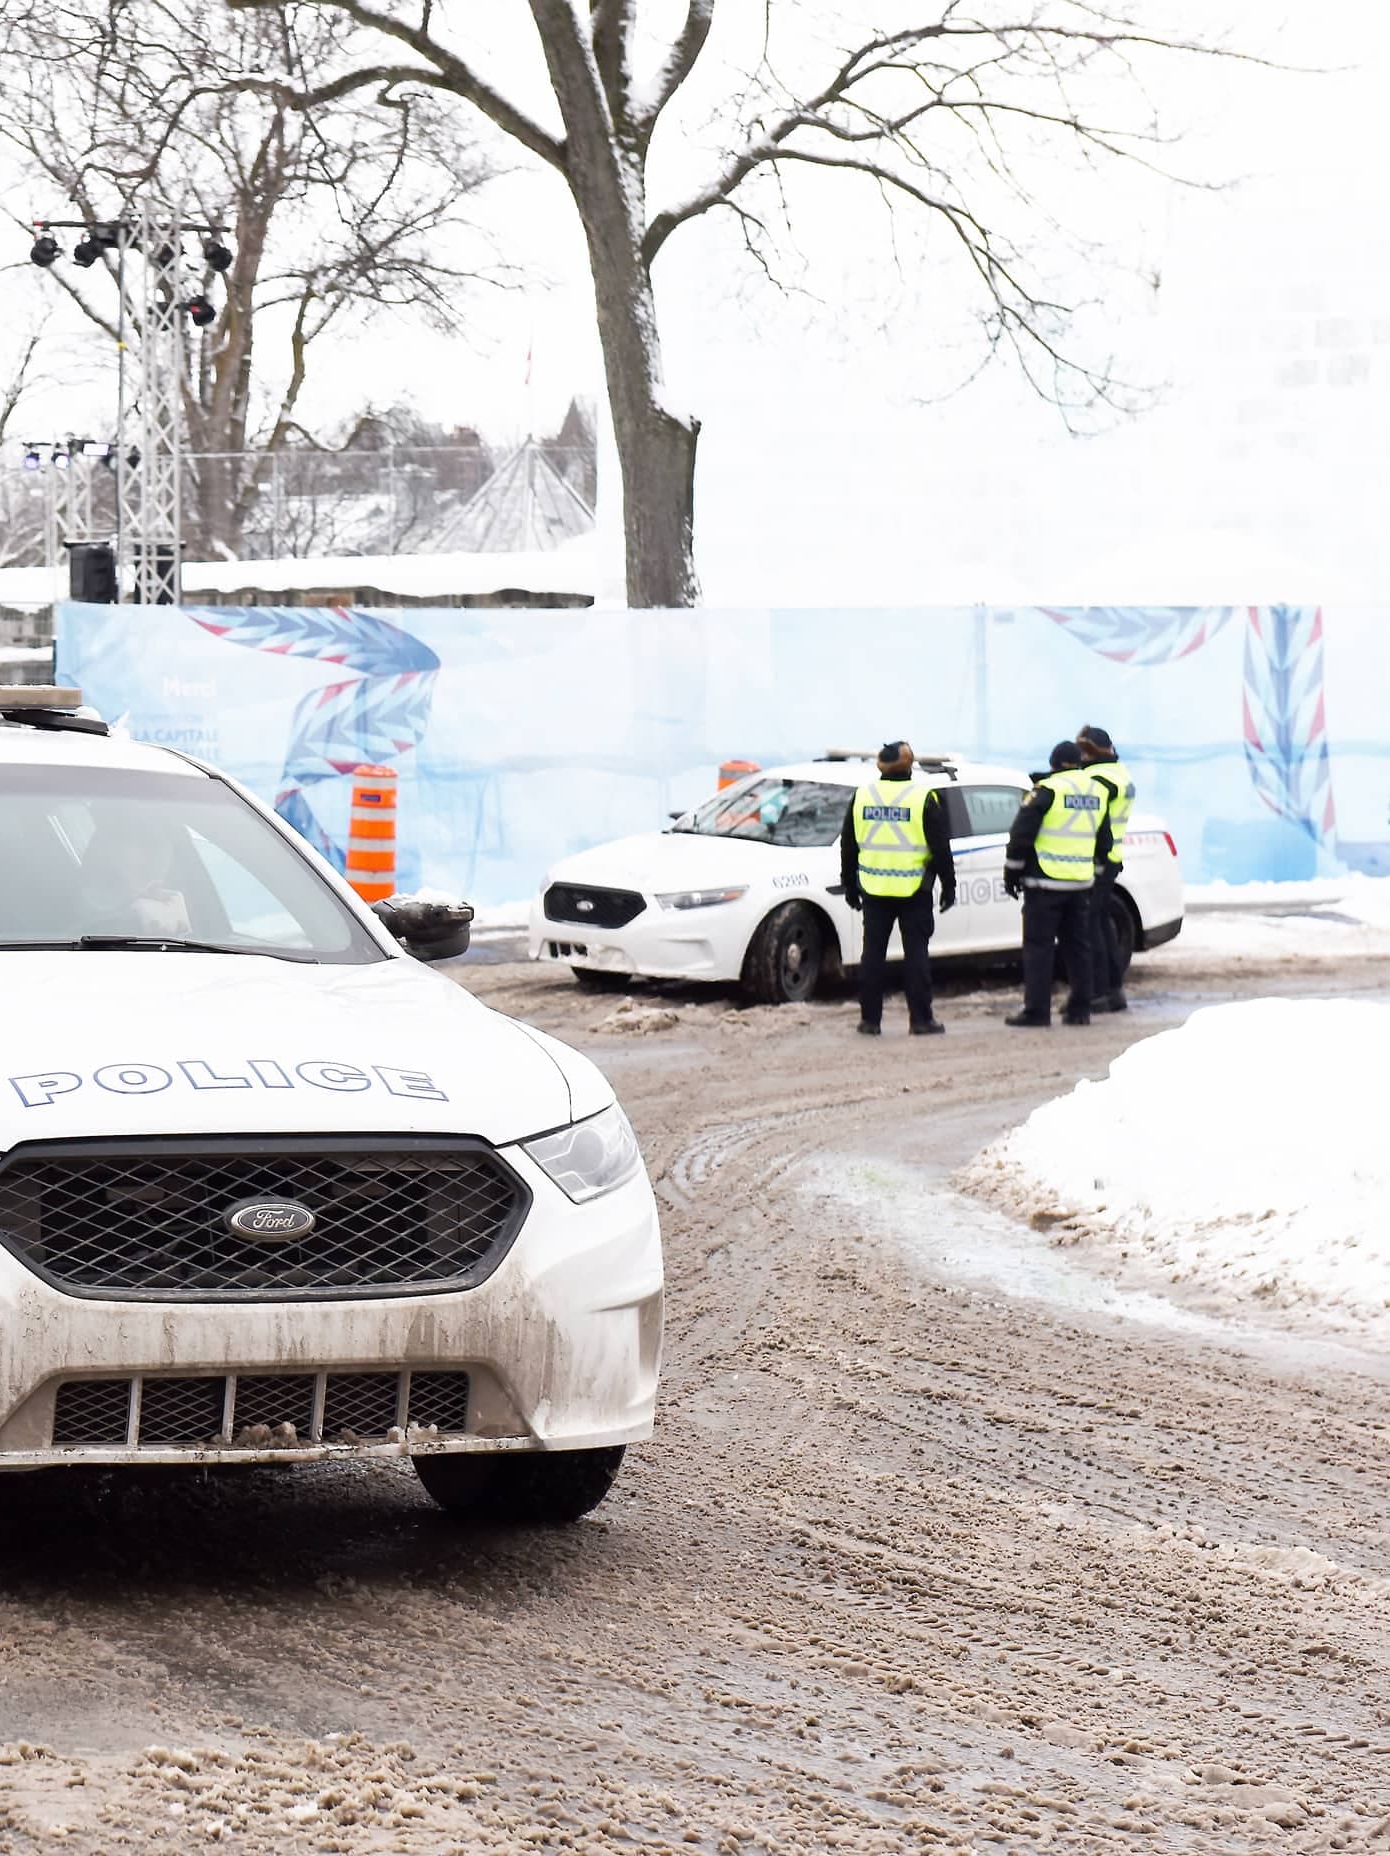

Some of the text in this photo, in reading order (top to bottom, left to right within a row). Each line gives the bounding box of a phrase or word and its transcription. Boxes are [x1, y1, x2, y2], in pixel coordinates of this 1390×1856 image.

[864, 808, 909, 820] POLICE
[9, 1058, 450, 1107] POLICE
[252, 1209, 295, 1229] Ford
